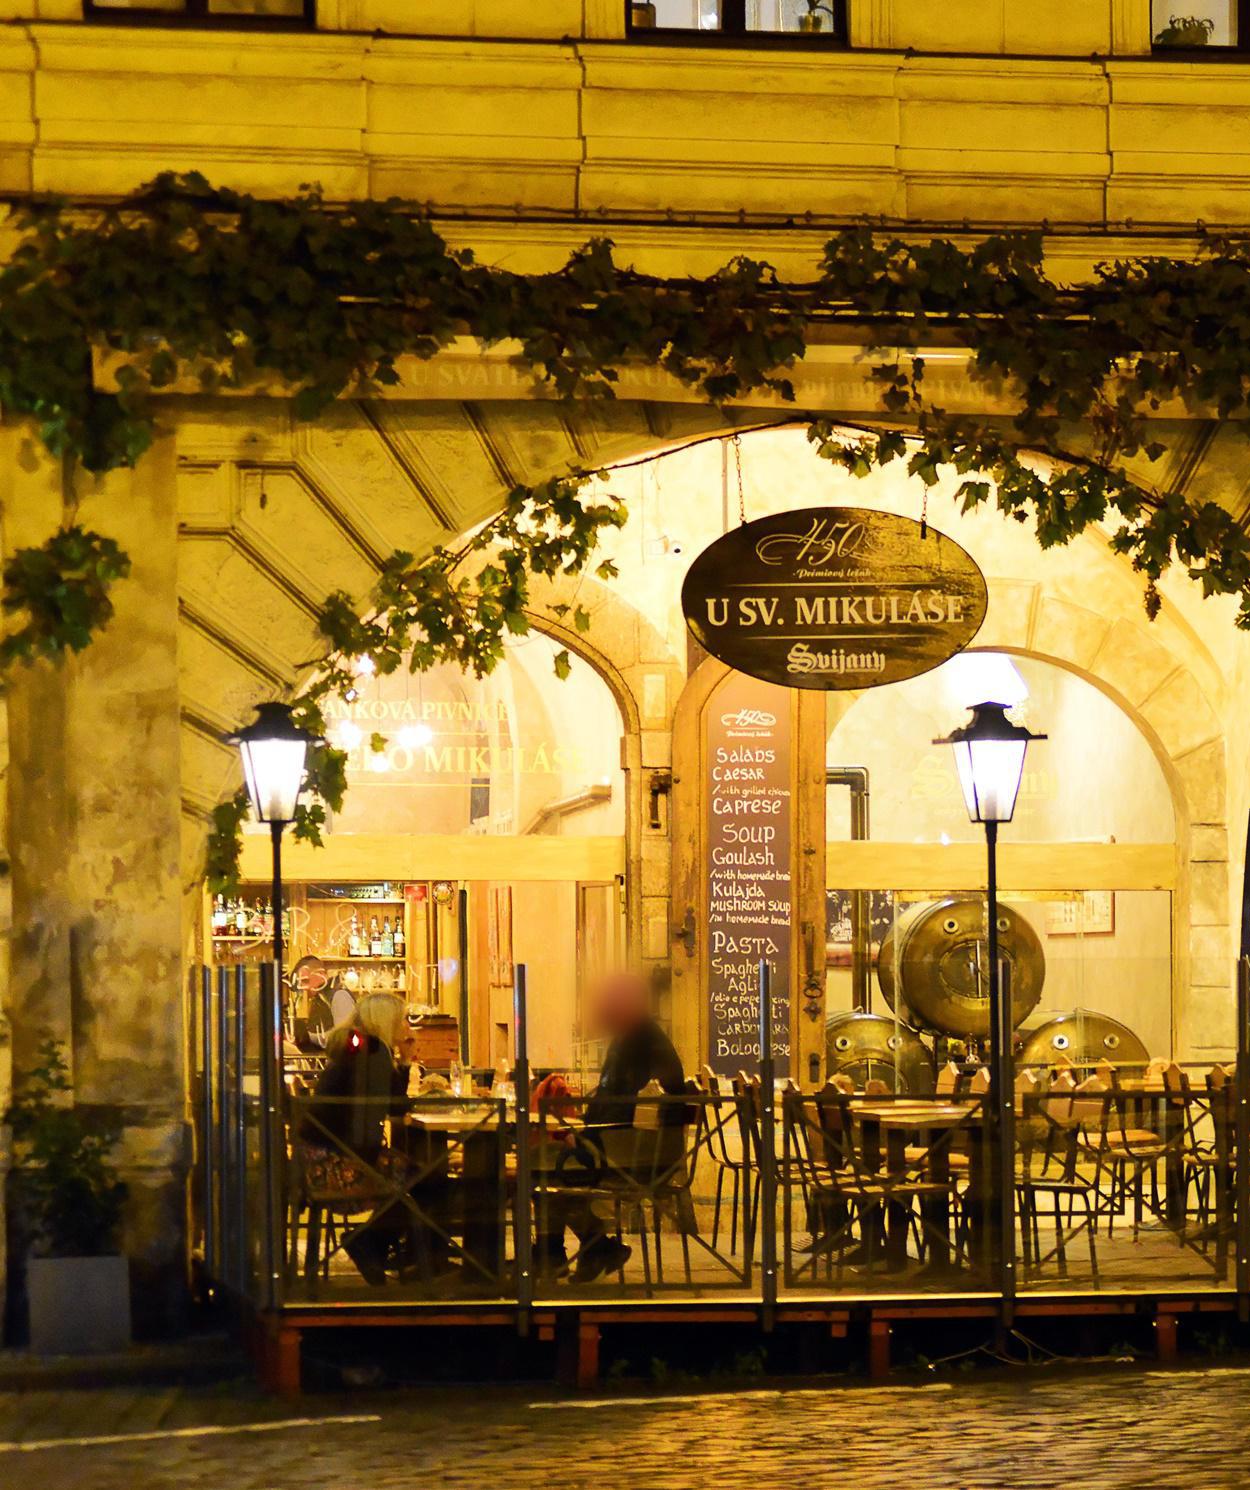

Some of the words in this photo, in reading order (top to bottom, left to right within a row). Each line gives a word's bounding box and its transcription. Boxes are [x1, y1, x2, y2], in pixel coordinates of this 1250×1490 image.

[756, 518, 866, 565] 450
[705, 598, 729, 626] U
[739, 598, 785, 626] SV.
[795, 589, 964, 625] MIKULÁŠE
[787, 643, 885, 674] Svijany
